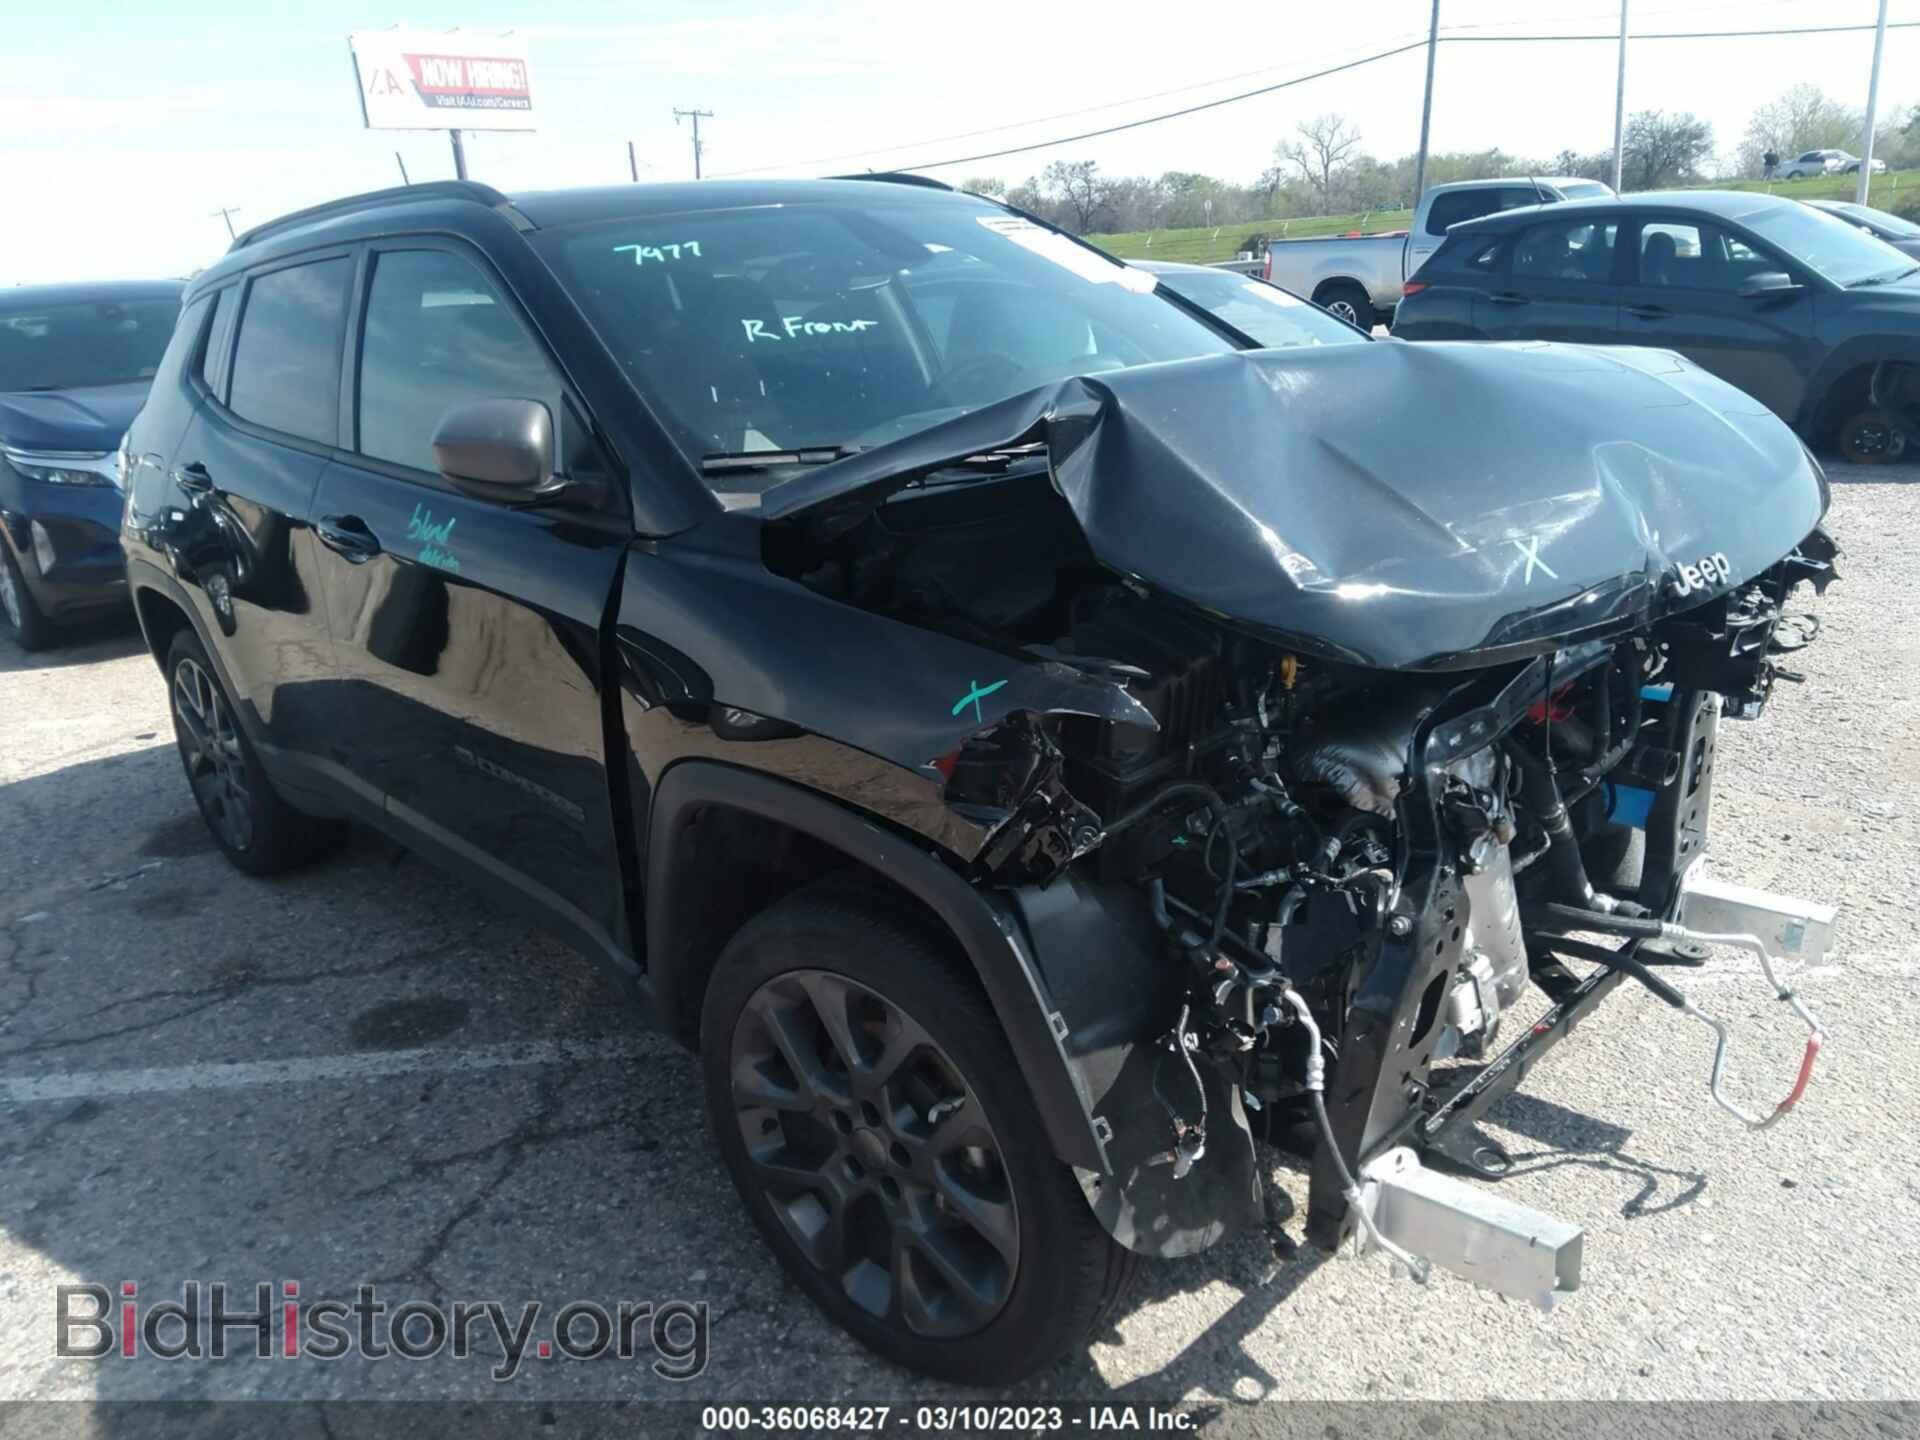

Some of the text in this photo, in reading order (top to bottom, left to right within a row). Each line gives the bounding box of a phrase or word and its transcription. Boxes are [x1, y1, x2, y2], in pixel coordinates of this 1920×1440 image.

[418, 58, 463, 87] NOW
[465, 59, 528, 91] HIRING!
[741, 316, 879, 342] R Front
[1673, 551, 1732, 597] Jeep
